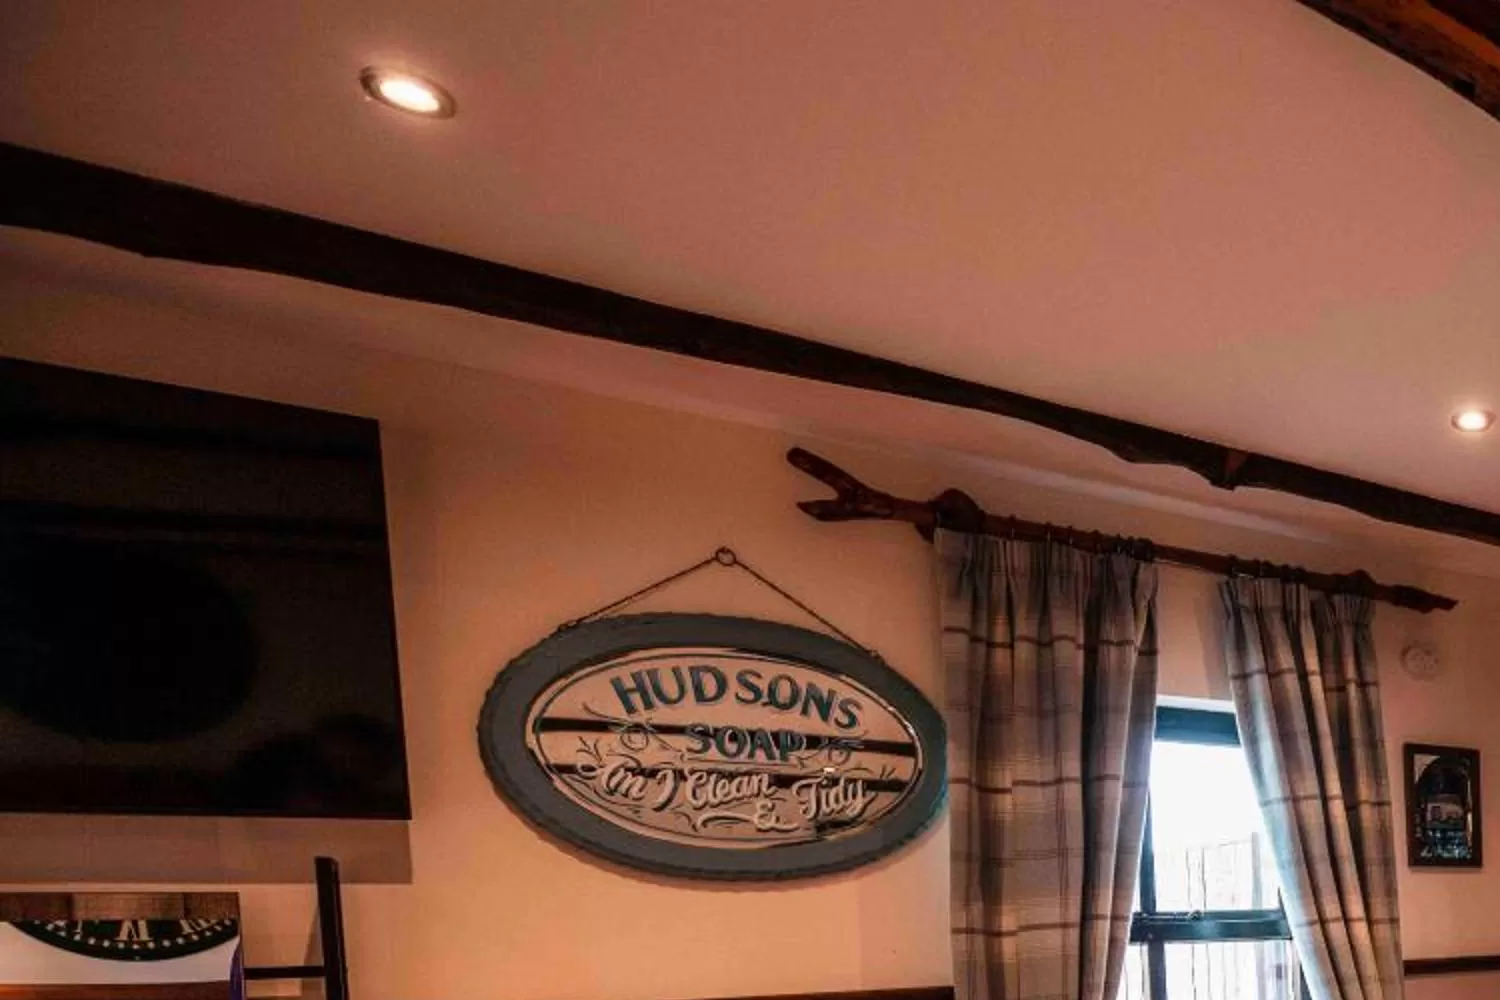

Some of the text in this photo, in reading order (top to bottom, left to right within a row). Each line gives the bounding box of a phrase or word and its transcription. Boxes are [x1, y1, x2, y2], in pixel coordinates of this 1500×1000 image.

[610, 665, 863, 730] HUDSONS
[684, 723, 803, 762] SOAP
[684, 766, 778, 811] Clean
[792, 774, 880, 822] Tidy
